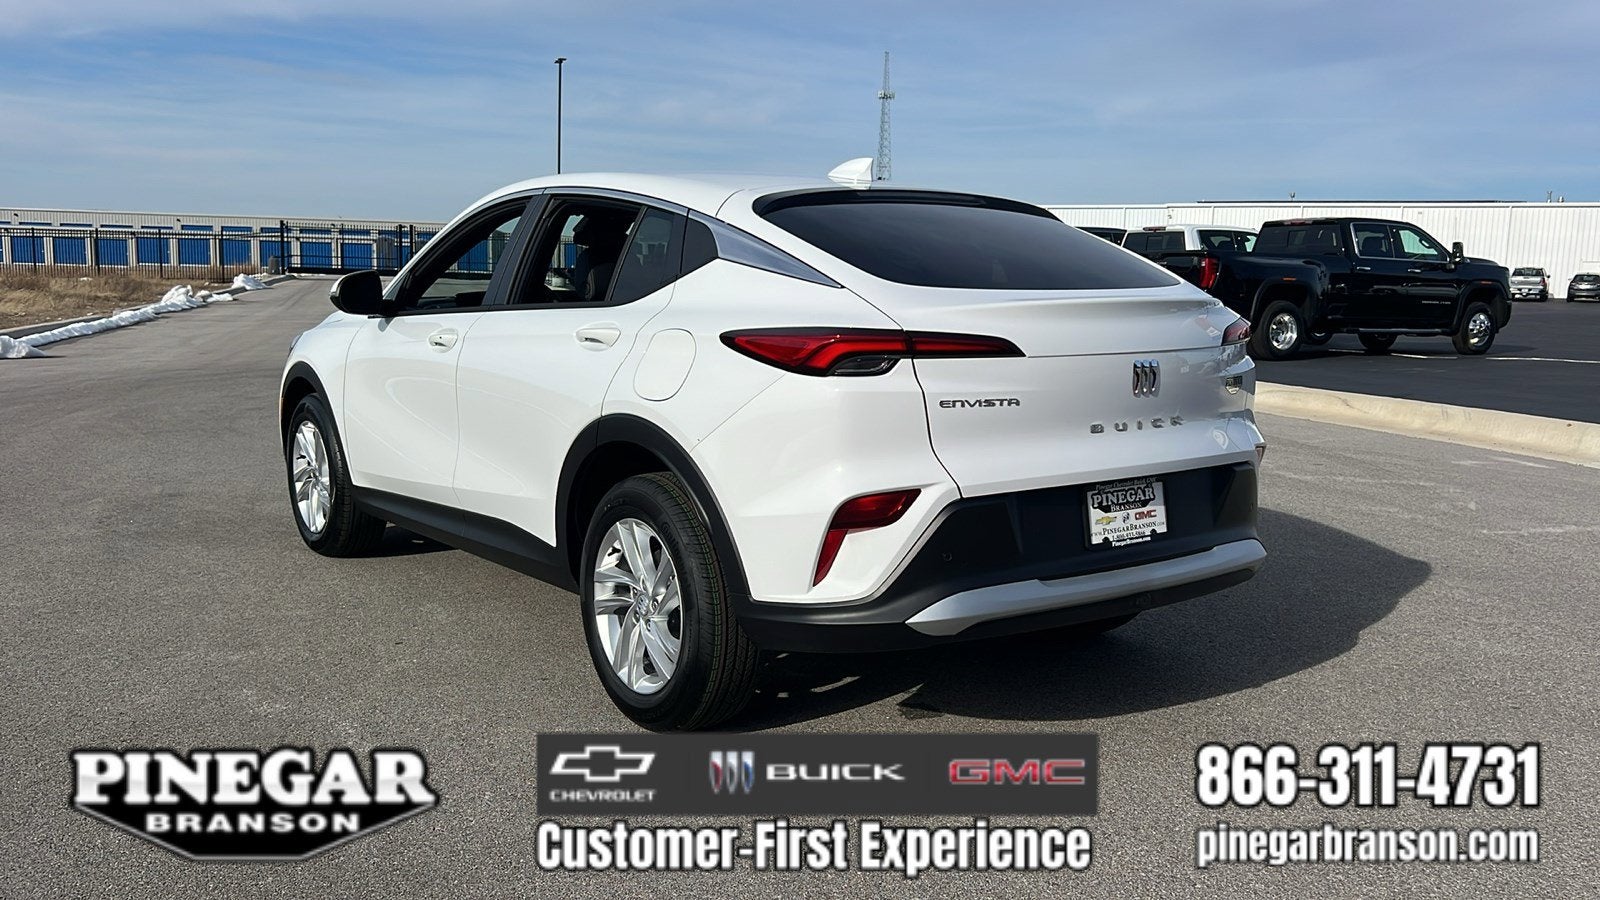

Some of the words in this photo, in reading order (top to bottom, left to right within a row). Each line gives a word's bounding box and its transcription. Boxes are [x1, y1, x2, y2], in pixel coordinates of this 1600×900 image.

[939, 398, 1020, 409] ENVISTA
[1090, 415, 1184, 434] BUICK
[1092, 487, 1155, 508] PINEGAR
[1110, 501, 1142, 513] BRANSON
[1134, 509, 1157, 521] GMC
